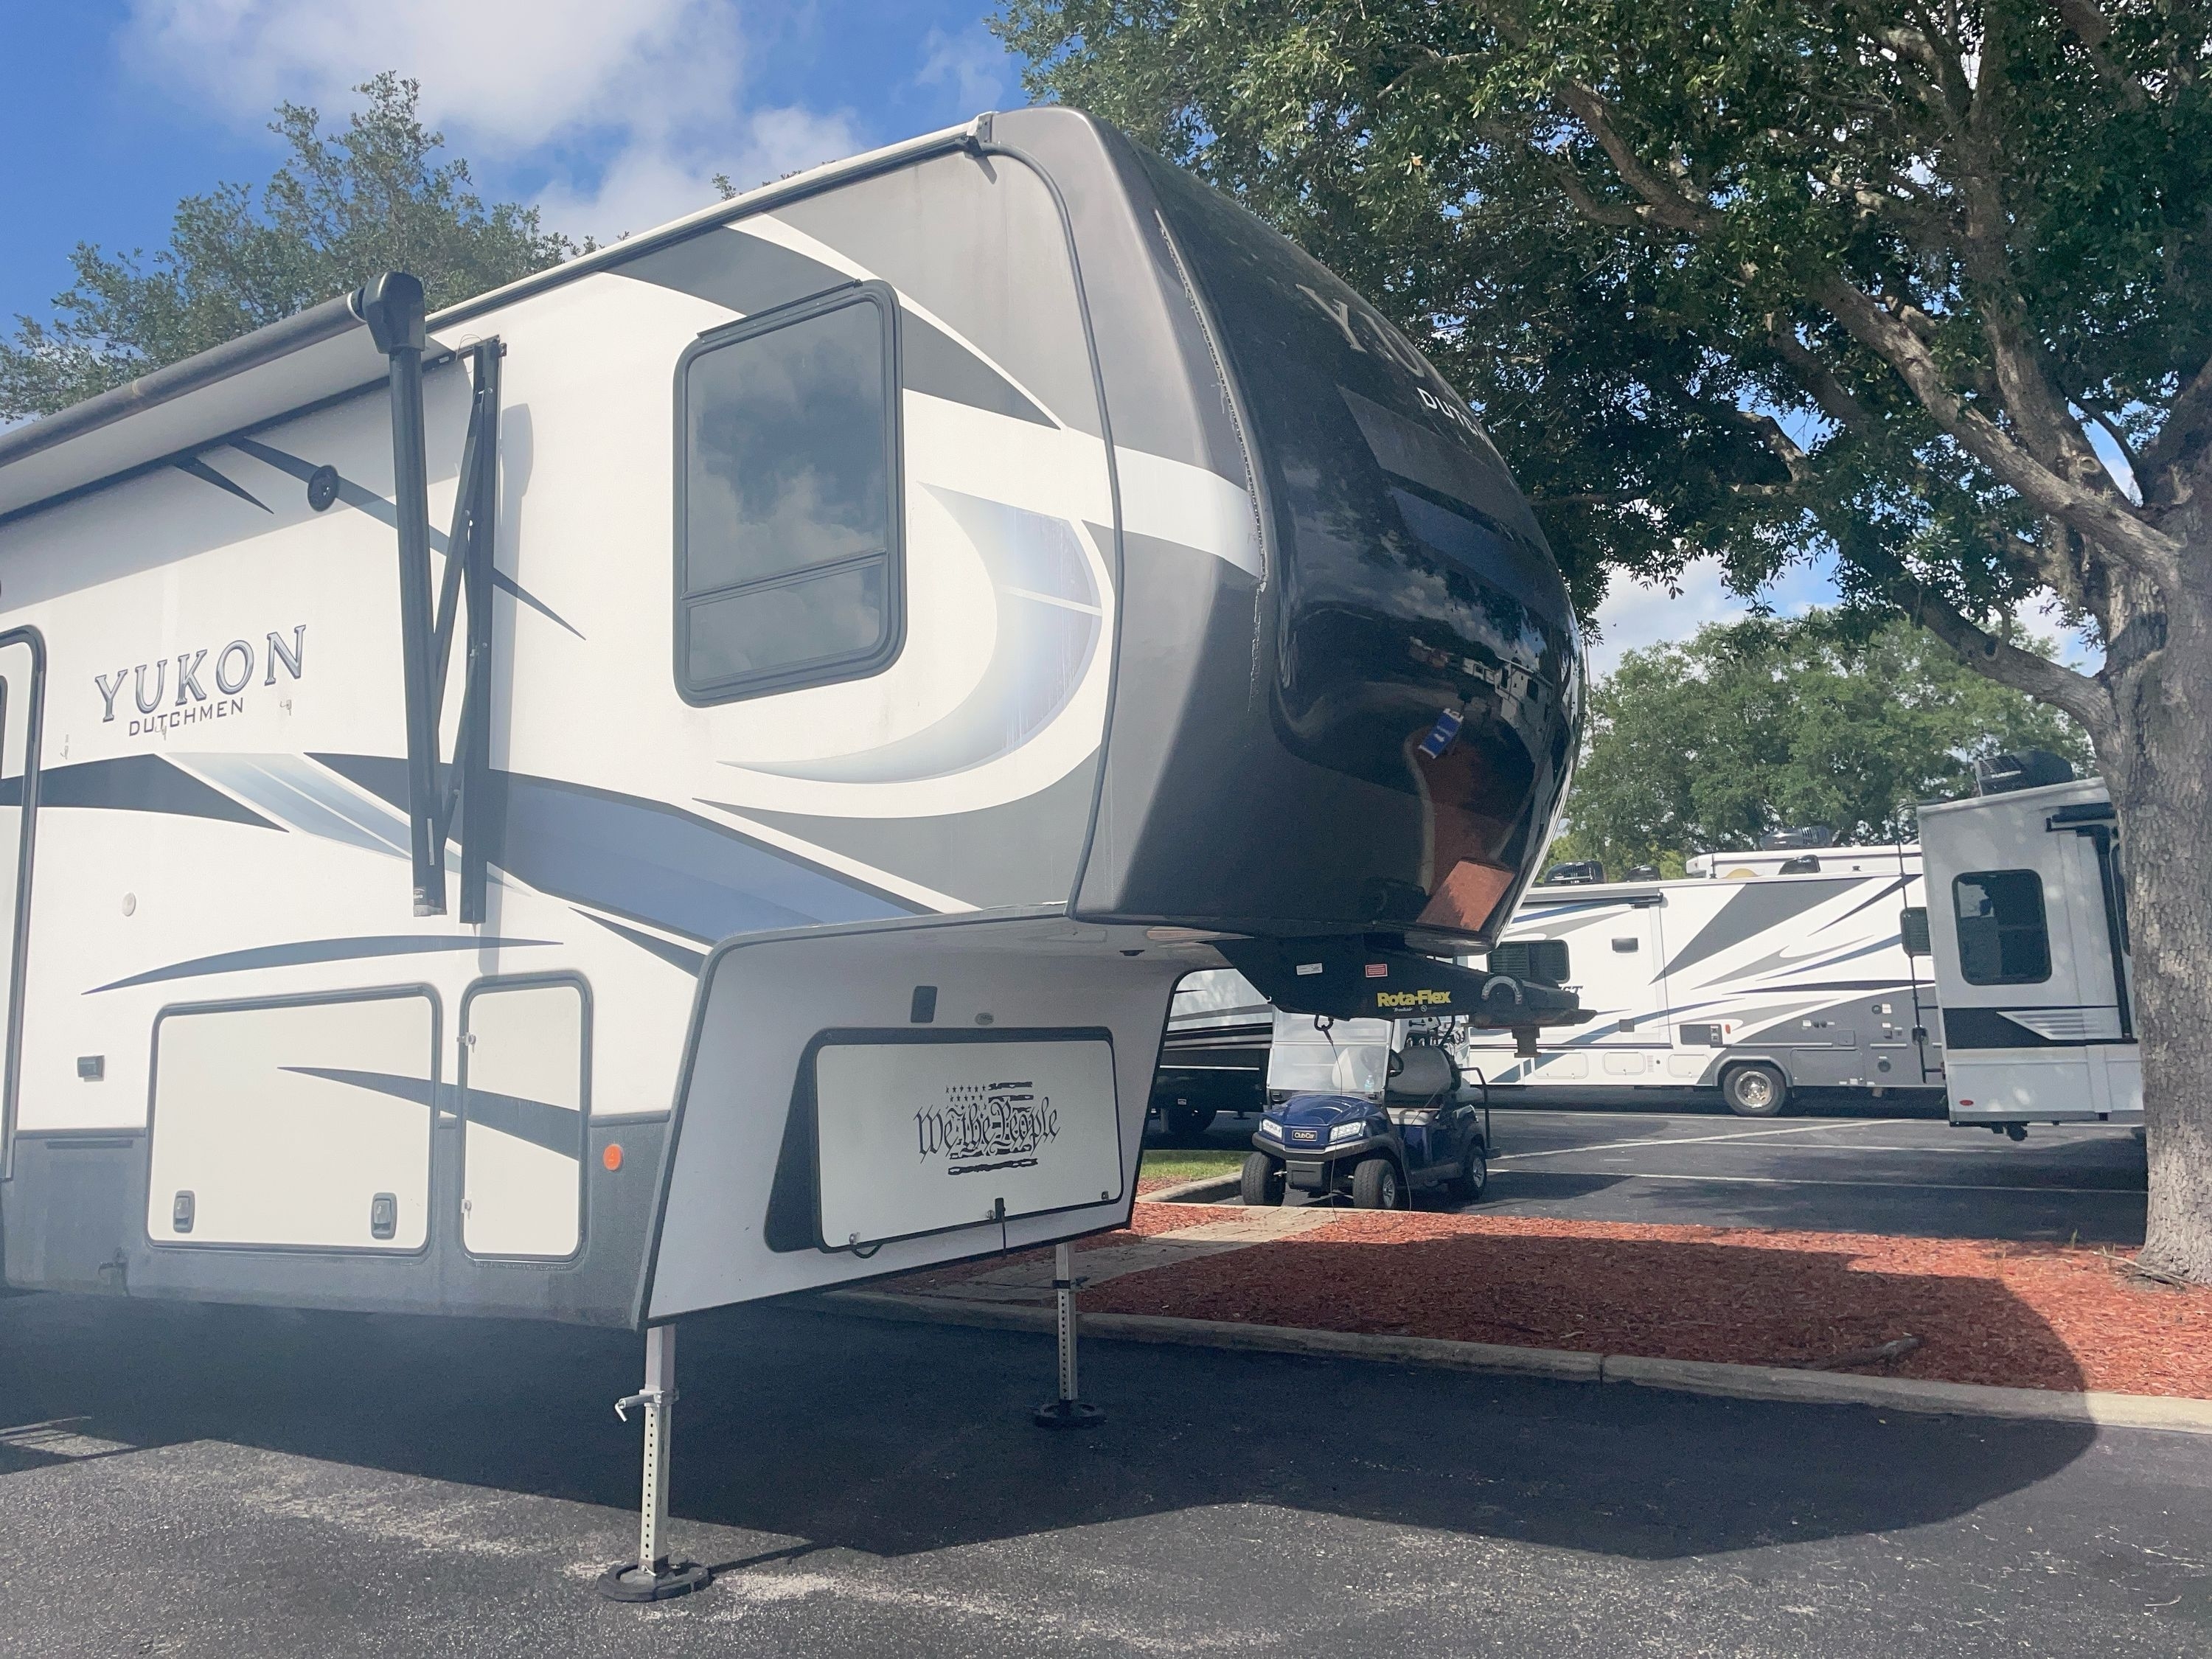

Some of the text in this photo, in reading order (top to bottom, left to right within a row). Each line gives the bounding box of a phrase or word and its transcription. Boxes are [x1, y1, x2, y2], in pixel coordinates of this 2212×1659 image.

[94, 625, 306, 723] YUKON
[129, 698, 244, 737] DUTCHMEN
[1377, 990, 1451, 1007] Rota-Flex
[914, 1096, 1060, 1164] We the People
